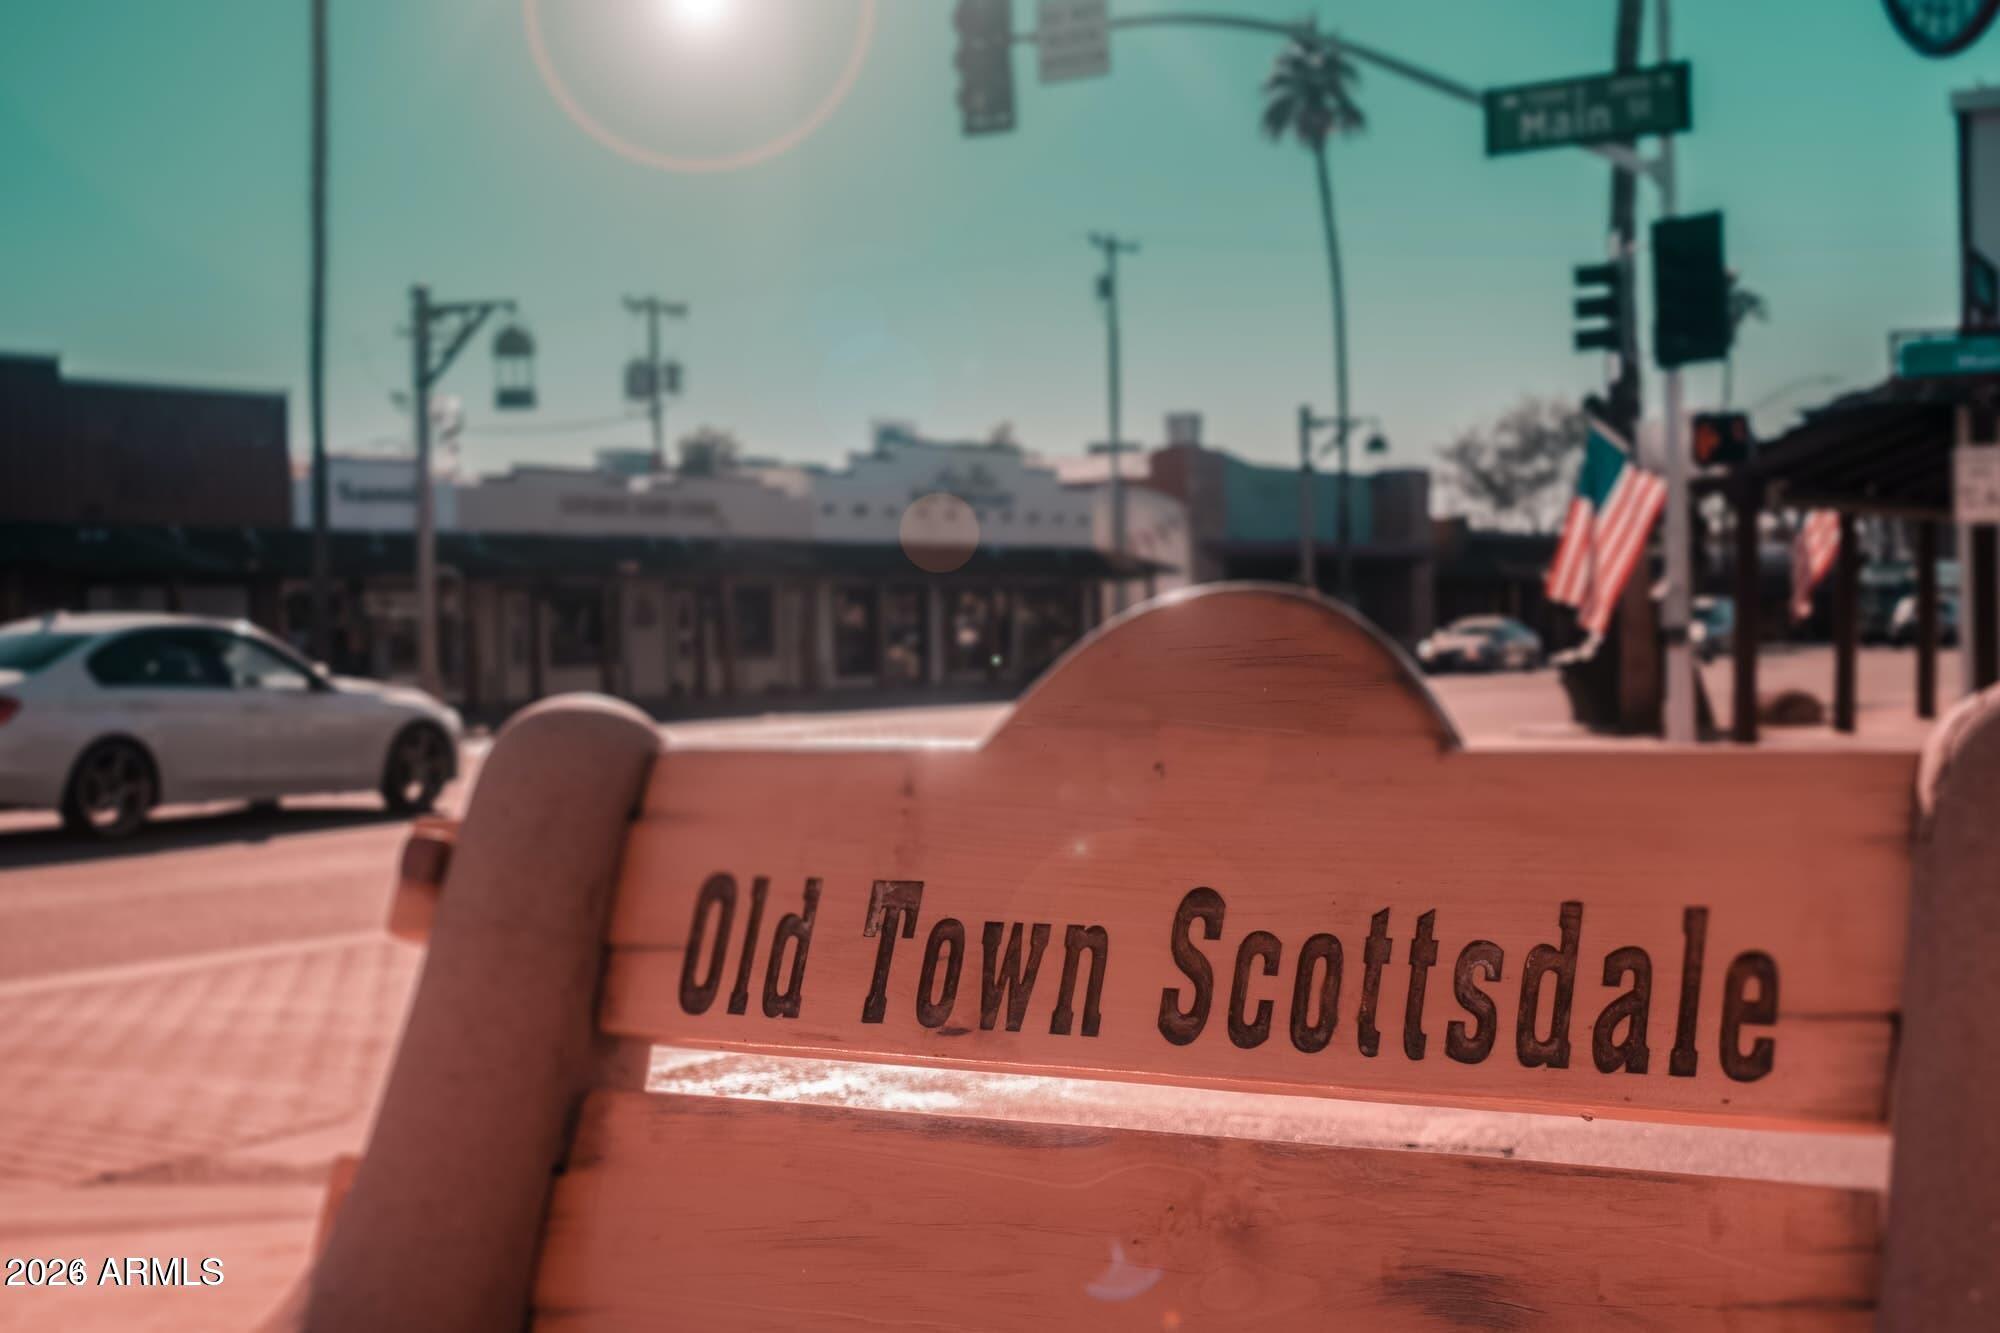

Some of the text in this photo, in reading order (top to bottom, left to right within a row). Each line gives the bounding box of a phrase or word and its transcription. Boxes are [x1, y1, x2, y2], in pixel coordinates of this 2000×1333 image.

[1519, 87, 1612, 143] Main
[678, 872, 1780, 1082] Old Town Scottsdale
